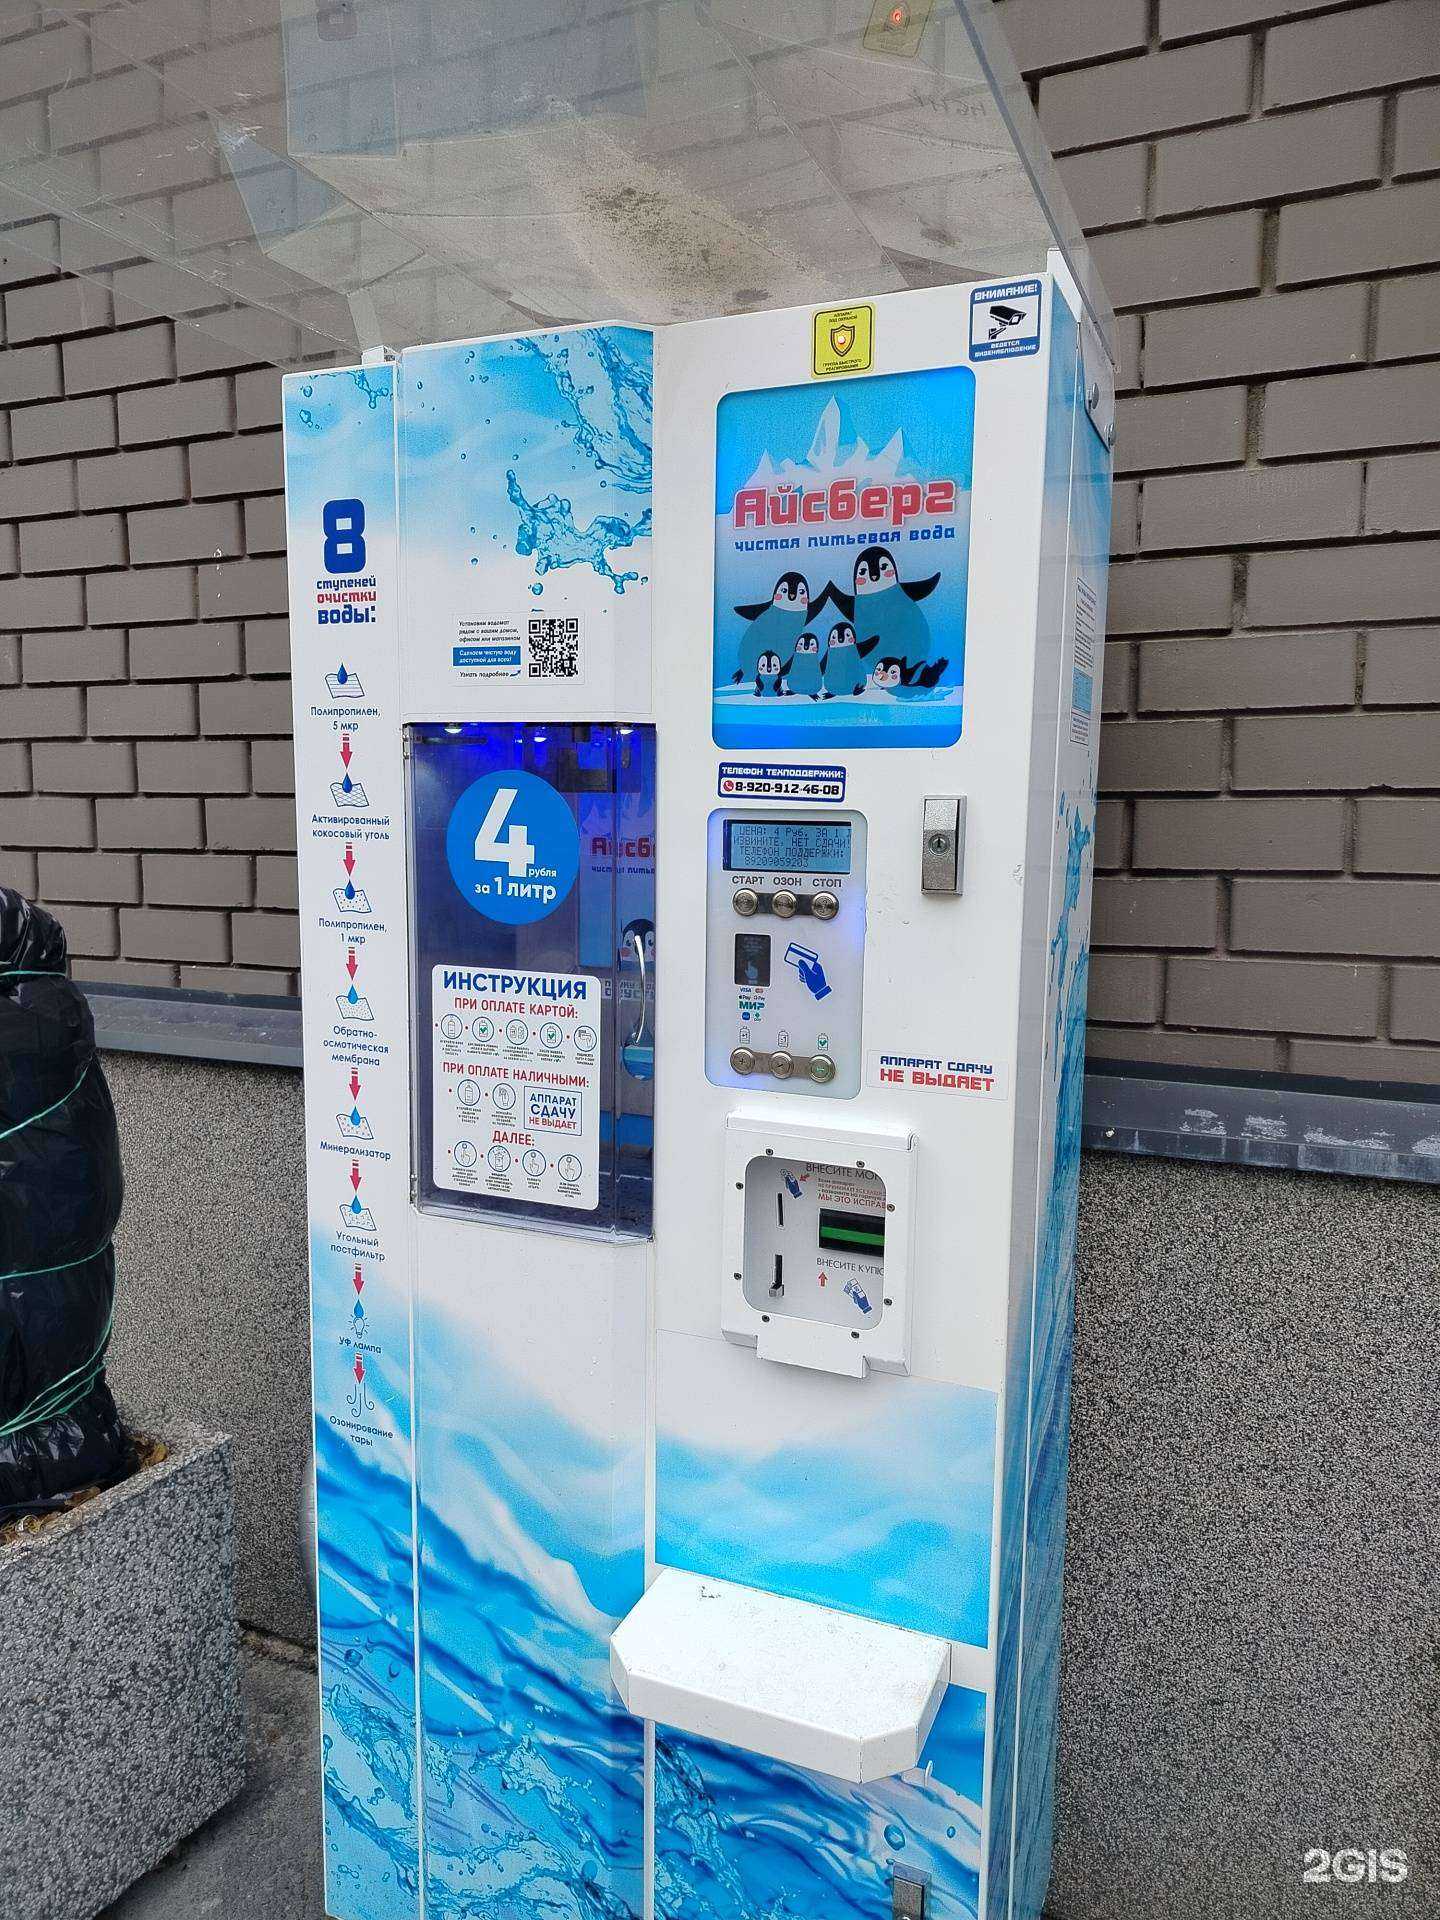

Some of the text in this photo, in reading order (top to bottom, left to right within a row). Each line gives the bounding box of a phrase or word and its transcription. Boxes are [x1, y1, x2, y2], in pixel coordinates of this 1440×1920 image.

[974, 284, 1038, 301] ВНИМАНИЕ!
[733, 478, 956, 529] Айсберг
[322, 499, 367, 574] 8
[734, 525, 956, 552] чистая питьевая вода
[316, 574, 377, 591] ступеней
[317, 591, 377, 603] очистки
[317, 604, 376, 625] воды:
[310, 706, 381, 718] Полипропилен,
[332, 720, 359, 732] 5 мкр
[721, 766, 844, 779] ТЕЛЕФОН ТЕХПОДДЕРЖКИ:
[735, 781, 840, 796] 8-920-912-46-08
[311, 813, 390, 826] Активированный
[312, 828, 390, 842] кокосовый уголь
[474, 788, 535, 878] 4
[791, 838, 809, 847] НЕТ
[528, 867, 557, 878] рубля
[732, 876, 764, 885] СТАРТ
[773, 877, 802, 886] ОЗОН
[812, 879, 842, 888] СТОП
[474, 876, 557, 904] за 1 литр
[318, 917, 387, 933] Полипропилен,
[347, 934, 366, 946] мкр
[443, 971, 587, 999] ИНСТРУКЦИЯ
[454, 997, 579, 1019] ПРИ ОПЛАТЕ КАРТОЙ:
[739, 1001, 765, 1010] МИР
[333, 1025, 378, 1038] Обратно-
[323, 1039, 389, 1054] осмотическая
[331, 1053, 380, 1066] мембрана
[880, 1056, 993, 1075] АППАРАТ СДАЧУ
[442, 1061, 590, 1088] ПРИ ОПЛАТЕ НАЛИЧНЫМИ:
[880, 1069, 995, 1091] НЕ ВЫДАЕТ
[529, 1092, 577, 1107] АППАРАТ
[530, 1104, 577, 1120] СДАЧУ
[528, 1116, 540, 1126] НЕ
[541, 1119, 577, 1130] ВЫДАЕТ
[492, 1130, 535, 1147] ДАЛЕЕ:
[320, 1140, 392, 1160] Минерализатор
[806, 1162, 852, 1178] ВНЕСИТЕ
[817, 1193, 832, 1202] МЫ
[834, 1195, 851, 1205] ЭТО
[335, 1230, 379, 1247] Угольный
[330, 1244, 386, 1263] постфильтр
[816, 1257, 857, 1272] ВНЕСИТЕ
[353, 1341, 382, 1354] лампа
[329, 1415, 394, 1439] Озонирование
[350, 1434, 373, 1446] тары
